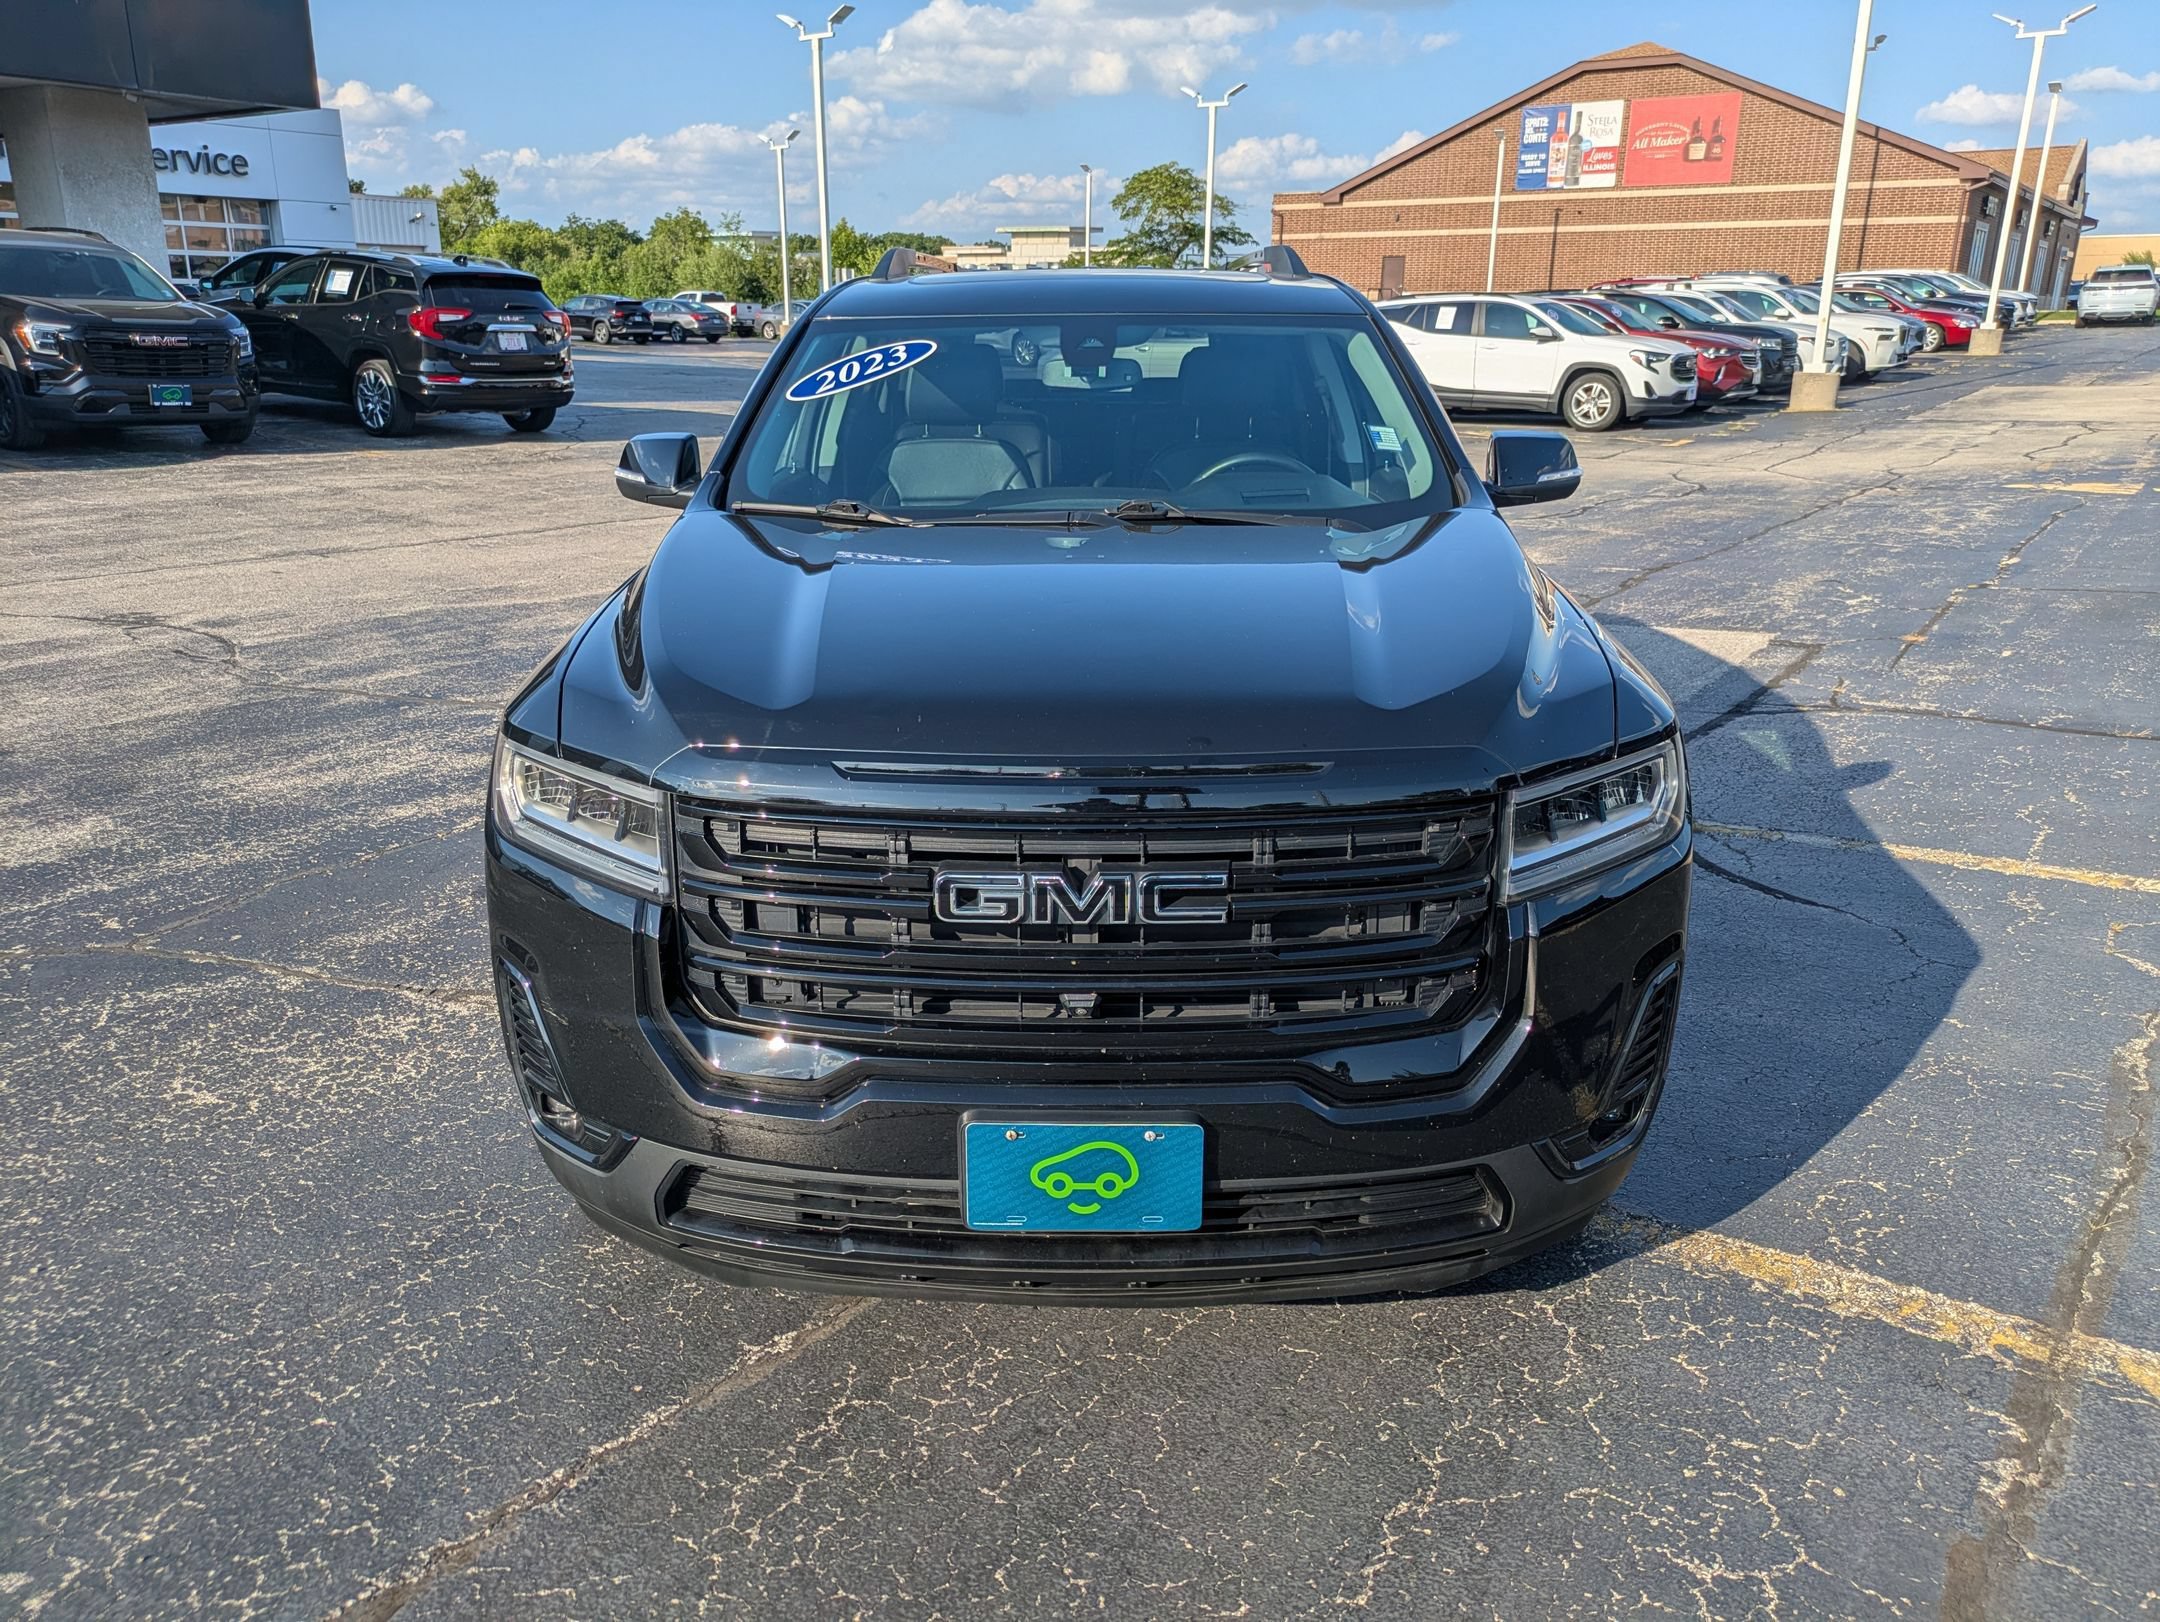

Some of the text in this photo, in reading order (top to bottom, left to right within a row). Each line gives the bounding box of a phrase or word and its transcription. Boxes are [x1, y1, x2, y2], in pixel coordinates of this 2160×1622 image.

[1587, 114, 1617, 127] STELLA
[1523, 133, 1548, 144] CONTE
[1589, 127, 1614, 138] ROSA
[1631, 136, 1648, 150] All
[152, 145, 249, 176] ervice
[1587, 148, 1614, 163] Loves
[1582, 163, 1616, 171] ILLINOIS
[136, 335, 188, 347] GMC
[815, 345, 907, 394] 2023
[934, 870, 1229, 924] GMC
